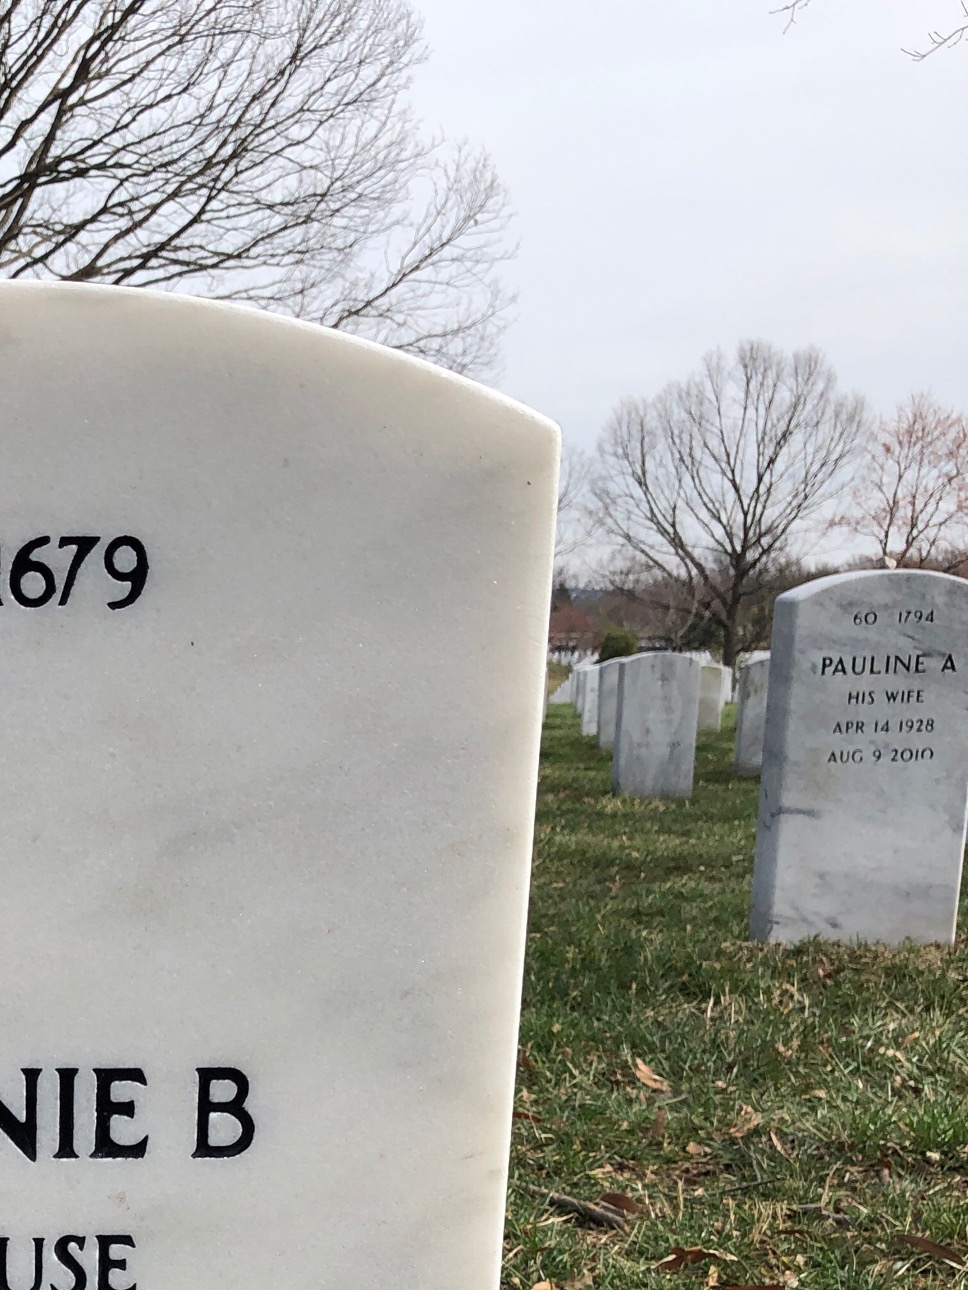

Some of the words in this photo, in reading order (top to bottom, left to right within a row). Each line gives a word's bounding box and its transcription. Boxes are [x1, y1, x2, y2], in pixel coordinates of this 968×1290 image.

[853, 612, 878, 626] 60
[898, 610, 935, 624] 1794
[821, 654, 927, 676] PAULINE
[941, 653, 957, 673] A
[848, 690, 875, 705] HIS
[885, 689, 925, 704] WIFE
[833, 720, 865, 734] APR
[874, 720, 890, 733] 14
[899, 718, 935, 734] 1928
[827, 748, 863, 764] AUG
[872, 748, 882, 762] 9
[890, 747, 934, 763] 2010
[191, 1066, 255, 1159] B
